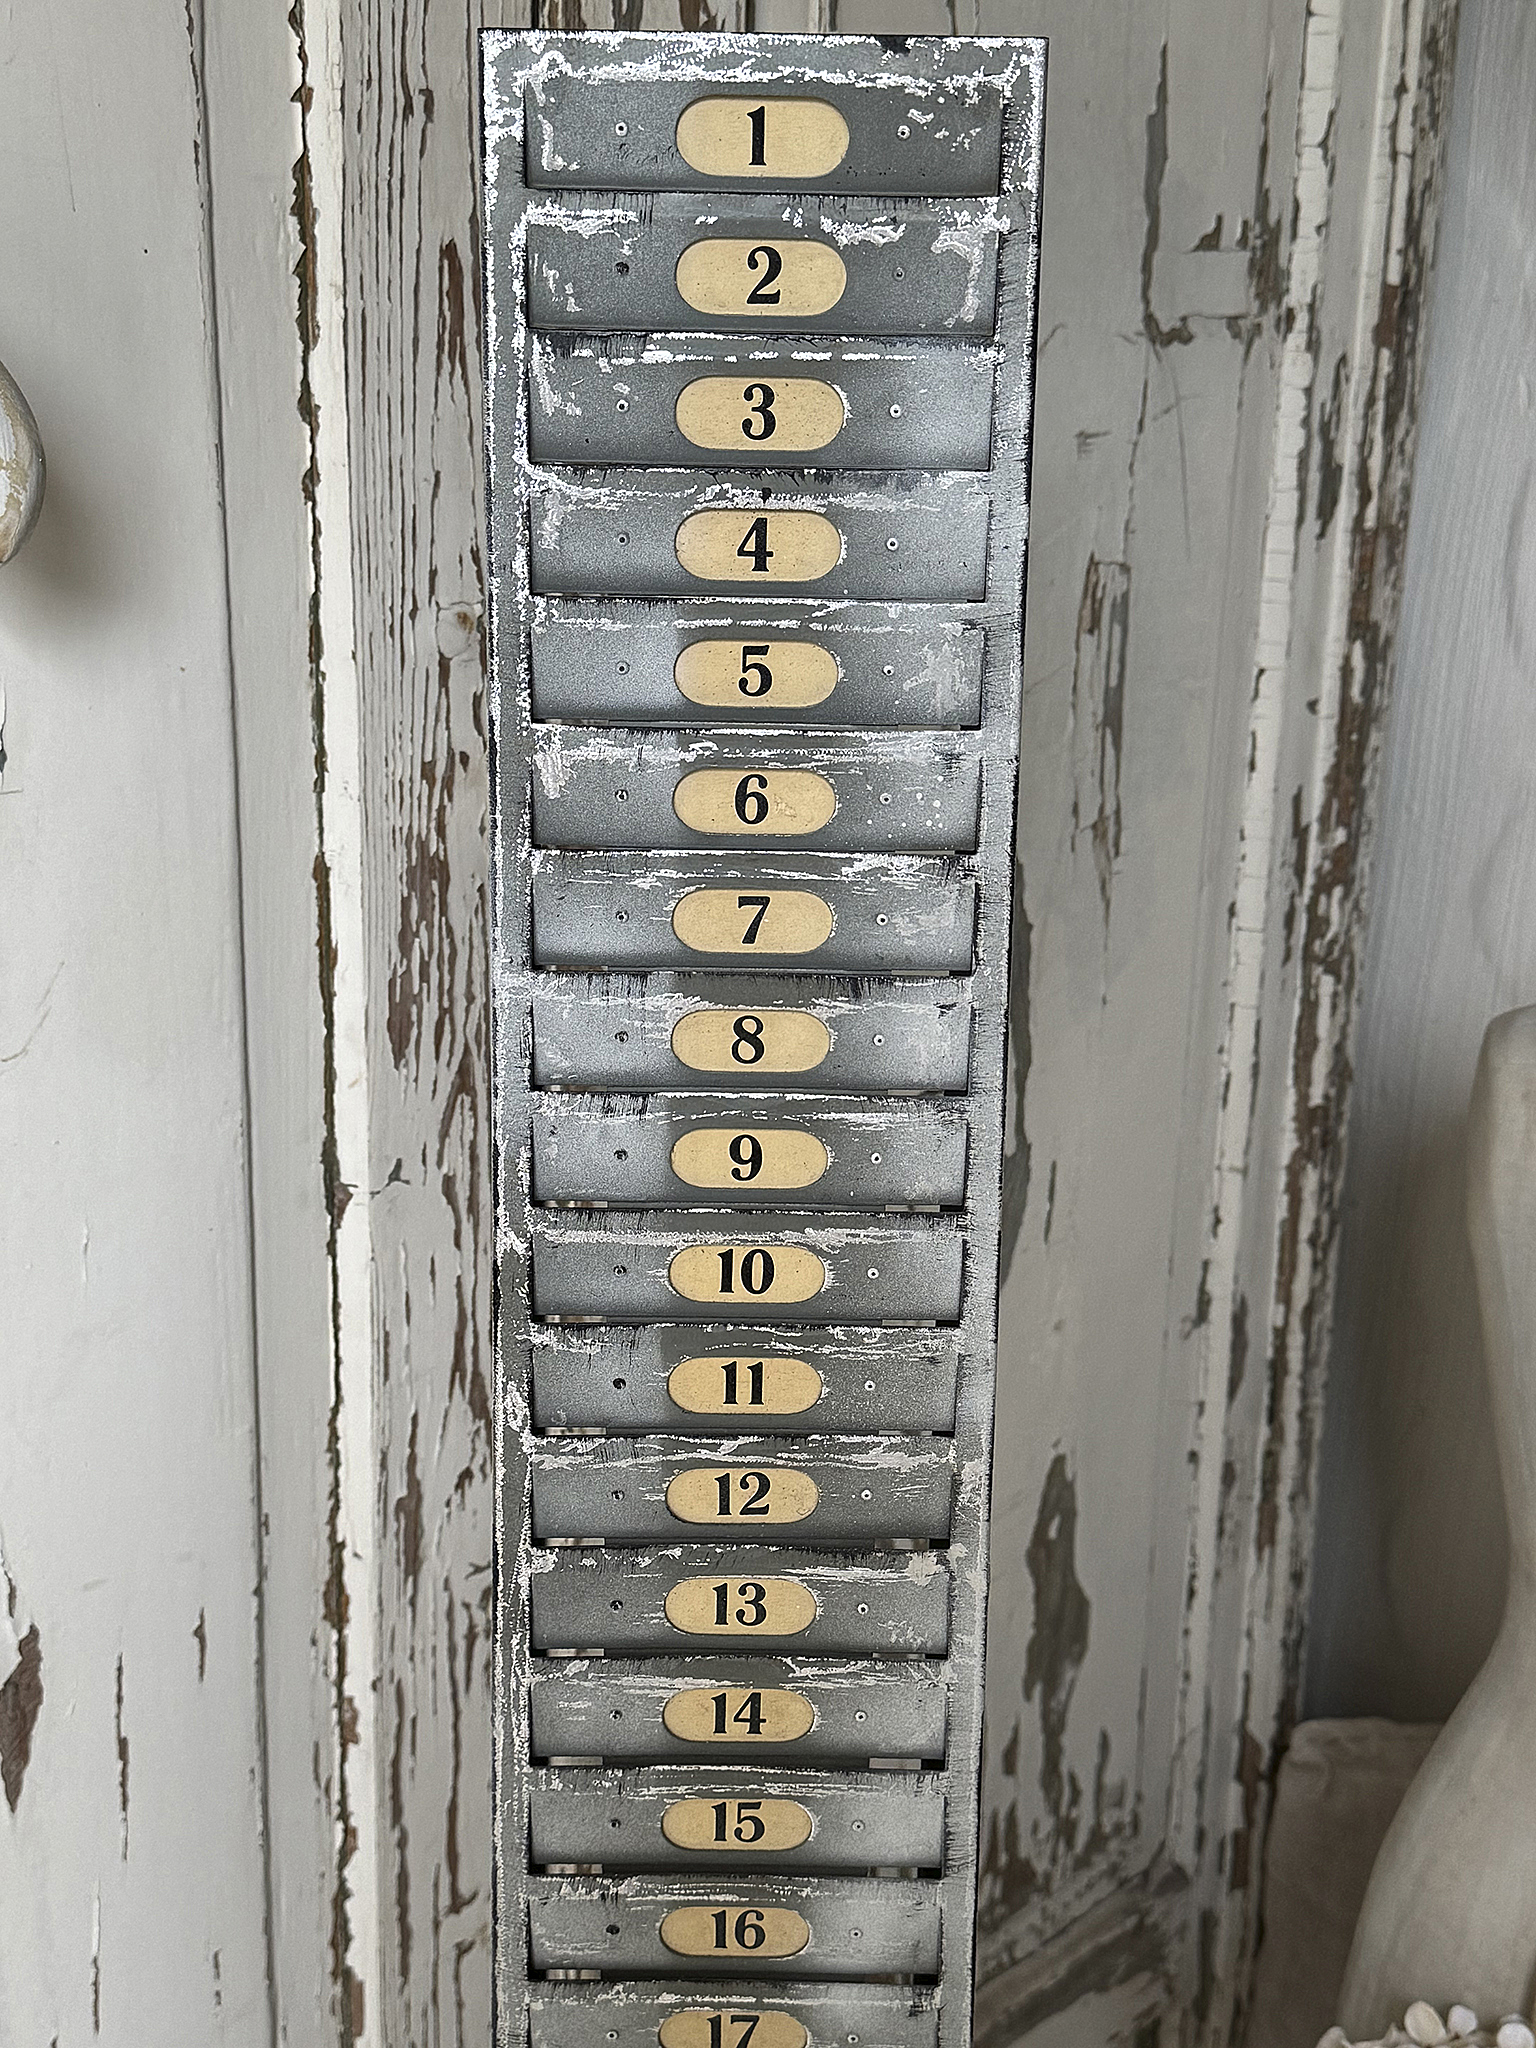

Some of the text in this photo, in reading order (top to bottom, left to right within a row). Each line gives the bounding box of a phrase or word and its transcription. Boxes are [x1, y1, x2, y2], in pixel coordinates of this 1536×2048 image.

[746, 105, 767, 167] 1
[746, 245, 783, 305] 2
[741, 382, 777, 441] 3
[736, 517, 774, 573] 4
[738, 644, 773, 697] 5
[734, 773, 769, 825] 6
[737, 895, 771, 945] 7
[731, 1014, 765, 1065] 8
[728, 1134, 763, 1182] 9
[716, 1248, 775, 1295] 10
[720, 1360, 765, 1406] 11
[714, 1471, 771, 1516] 12
[712, 1582, 767, 1627] 13
[710, 1691, 767, 1735] 14
[710, 1801, 766, 1843] 15
[710, 1909, 766, 1950] 16
[705, 2013, 761, 2048] 17
